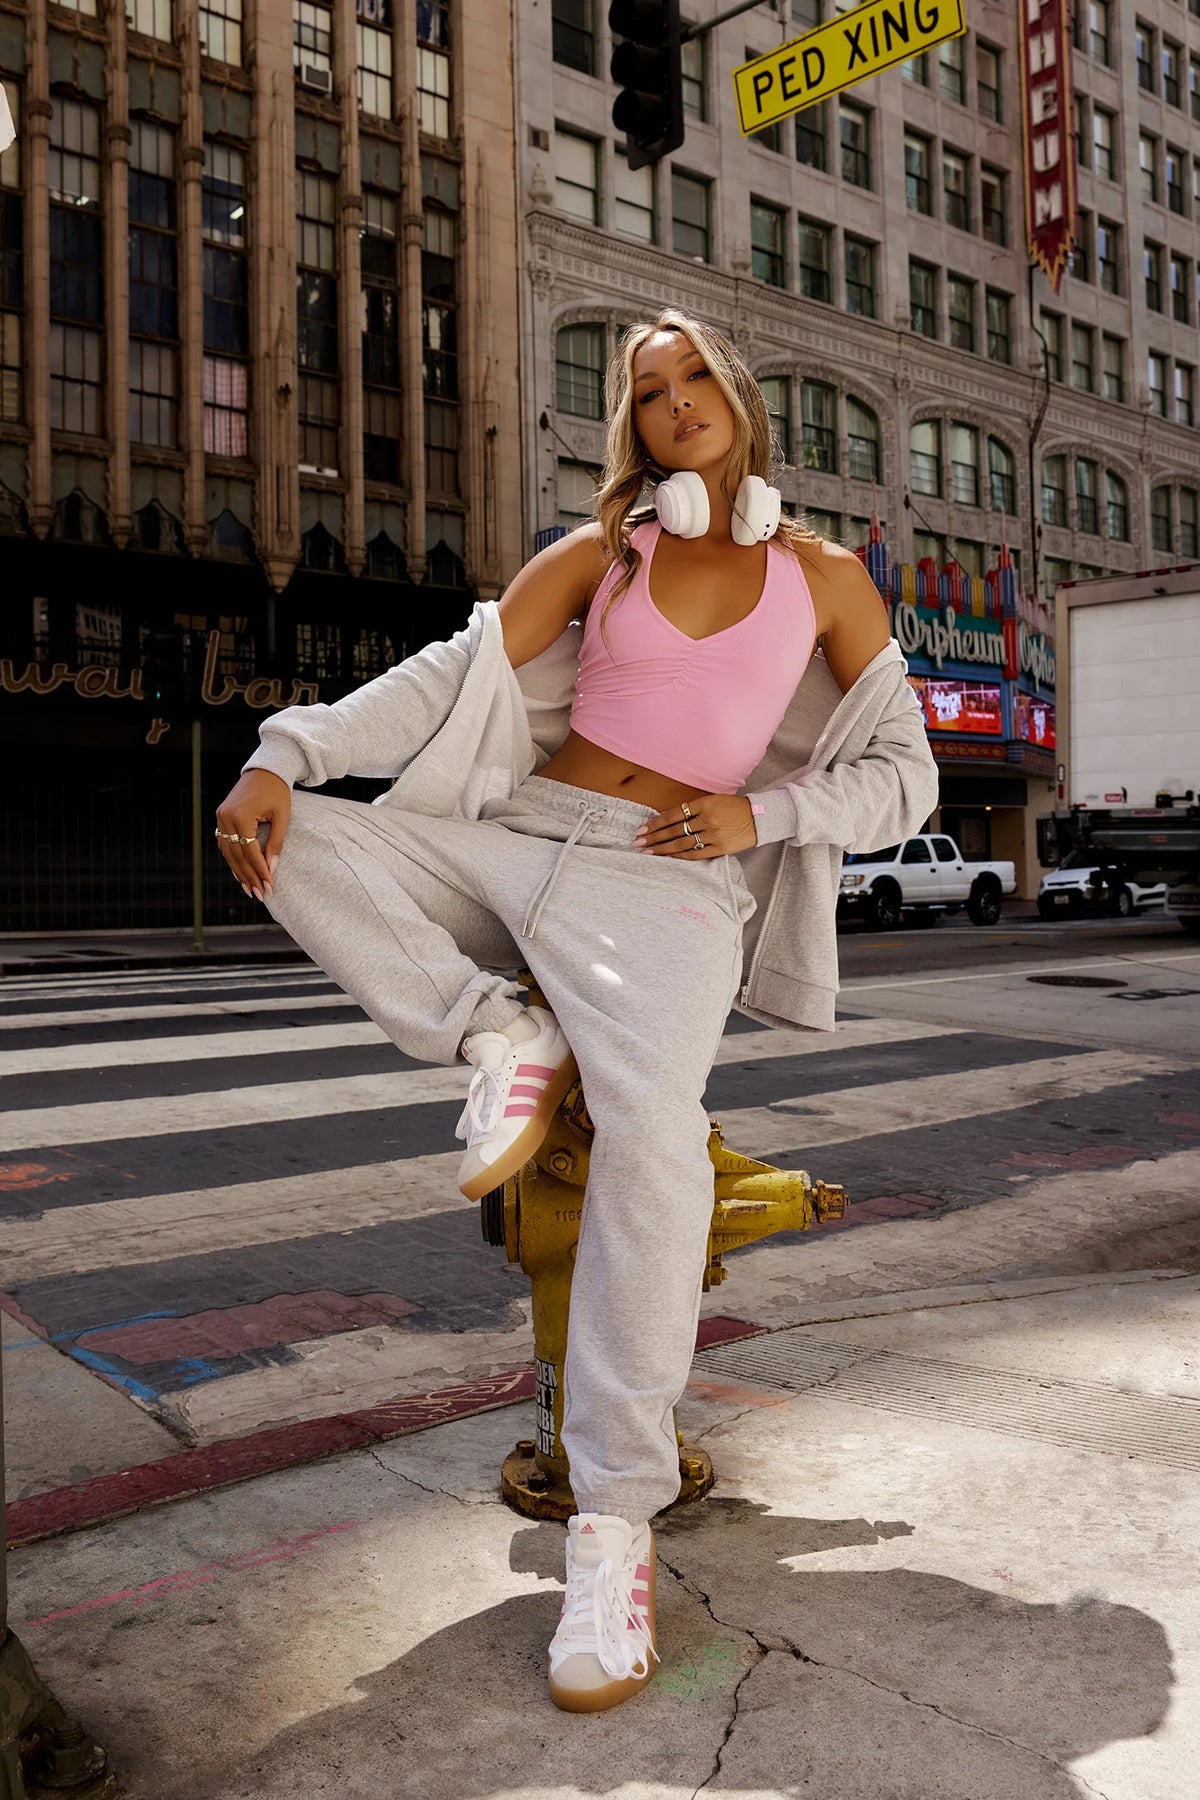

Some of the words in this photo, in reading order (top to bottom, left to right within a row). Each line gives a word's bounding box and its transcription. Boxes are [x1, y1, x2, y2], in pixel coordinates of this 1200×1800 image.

[752, 46, 825, 114] PED
[843, 0, 939, 71] XING
[201, 629, 319, 708] bar
[895, 601, 1008, 670] Orpheum
[1018, 623, 1055, 693] Orphe
